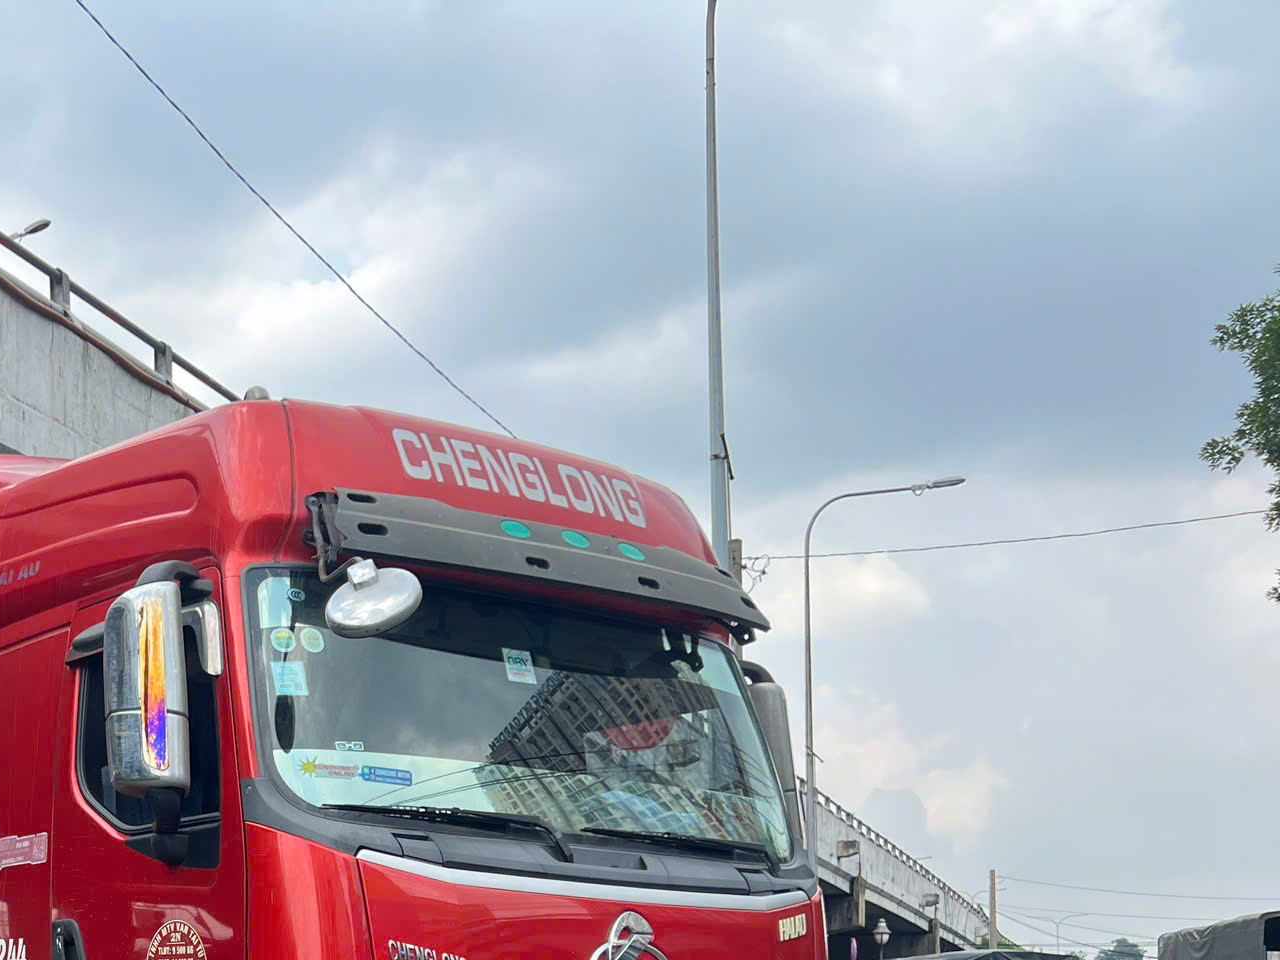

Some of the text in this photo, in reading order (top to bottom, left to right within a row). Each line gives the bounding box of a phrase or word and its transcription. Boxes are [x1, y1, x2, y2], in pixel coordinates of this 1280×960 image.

[391, 427, 646, 528] CHENGLONG
[148, 934, 162, 958] TNHH
[161, 922, 175, 938] MTV
[188, 929, 199, 946] TAI
[195, 944, 205, 958] TU
[170, 932, 182, 942] 2N
